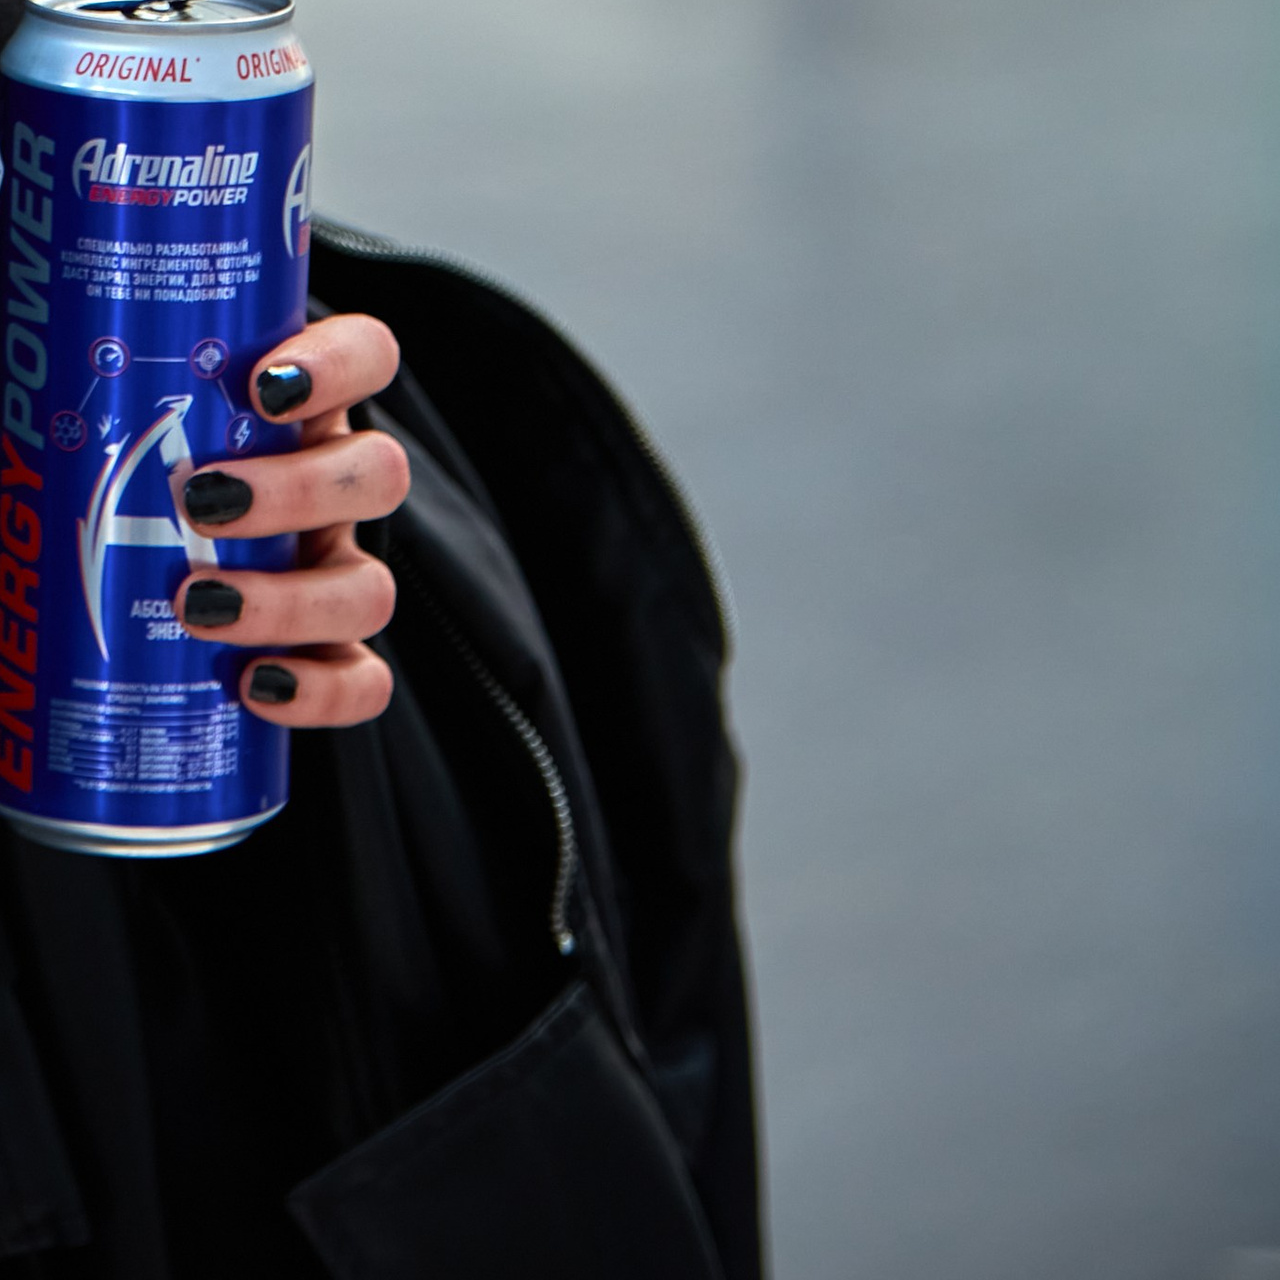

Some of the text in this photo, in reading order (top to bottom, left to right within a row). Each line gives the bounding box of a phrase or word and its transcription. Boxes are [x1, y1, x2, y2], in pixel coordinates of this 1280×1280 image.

[72, 138, 260, 200] Adrenaline
[77, 237, 249, 256] СПЕЦИАЛЬНО РАЗРАБОТАННЫЙ
[61, 250, 263, 273] КОМПЛЕКС ИНГРЕДИЕНТОВ, КОТОРЫЙ
[61, 265, 90, 281] ДАСТ
[91, 269, 130, 286] ЗАРЯД
[191, 273, 215, 288] ДЛЯ
[218, 270, 243, 285] ЧЕГО
[245, 269, 260, 282] БЫ
[86, 285, 237, 303] ОН ТЕБЕ НИ ПОНАДОБИЛСЯ
